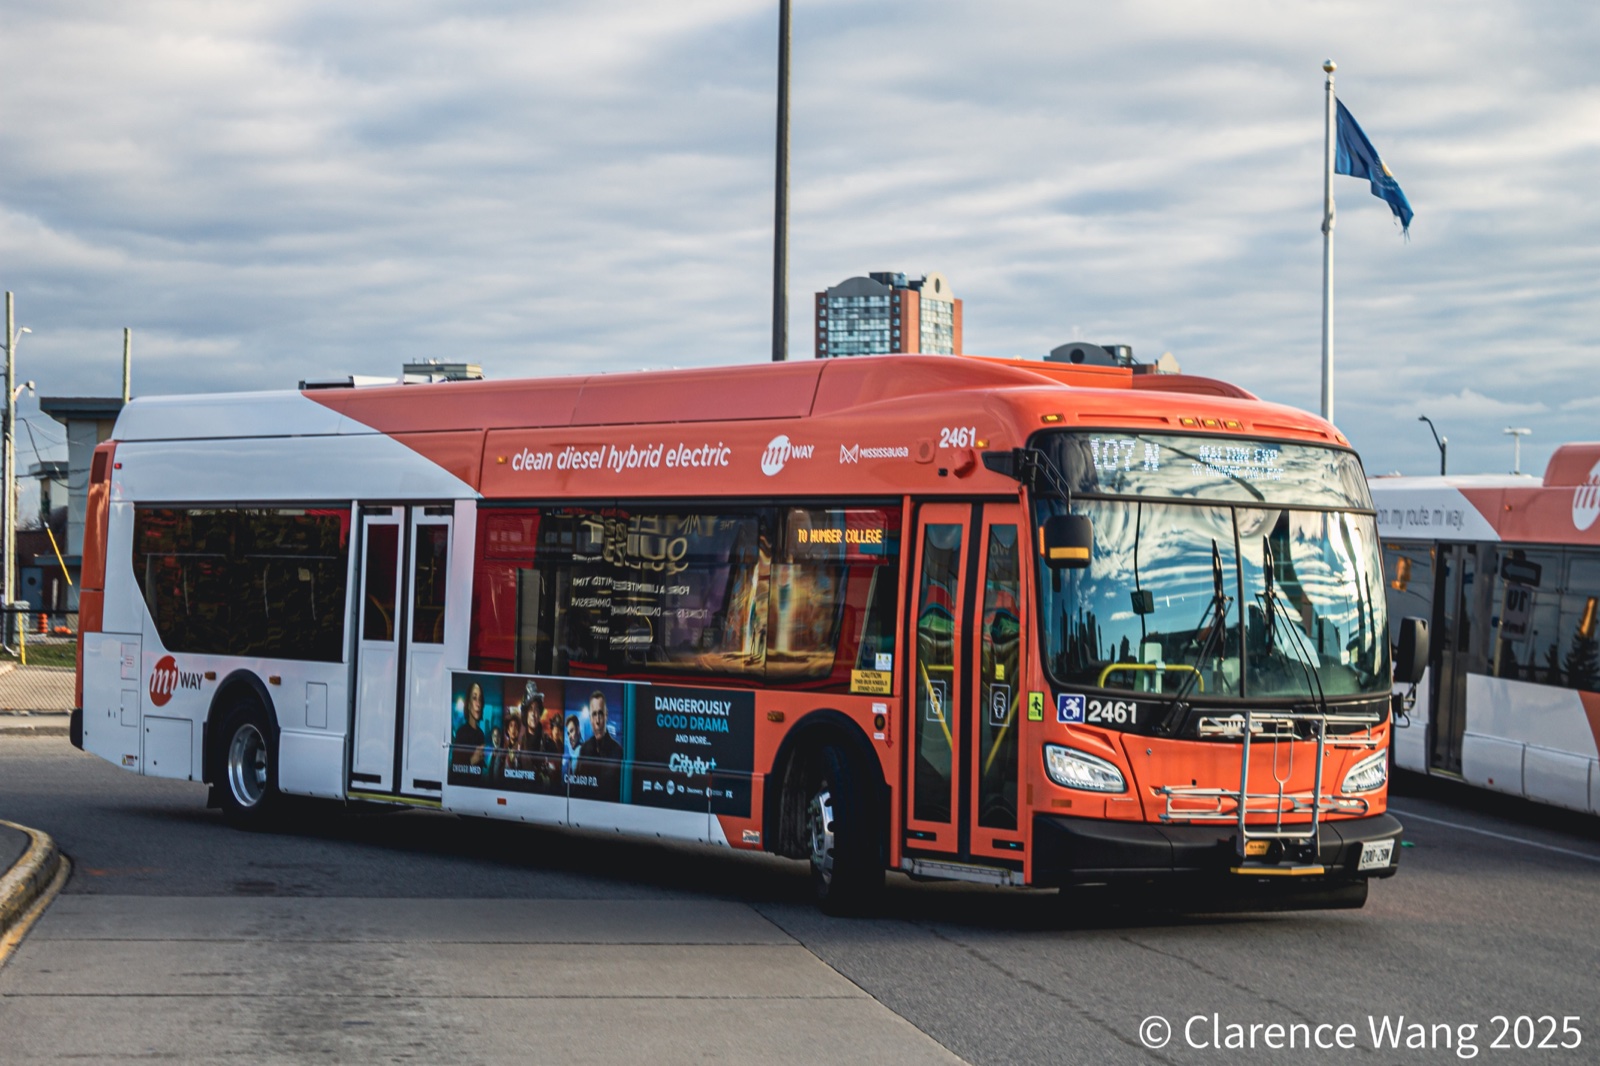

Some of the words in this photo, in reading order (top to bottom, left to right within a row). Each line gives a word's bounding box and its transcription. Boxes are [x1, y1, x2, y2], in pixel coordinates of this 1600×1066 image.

[939, 427, 976, 448] 2461
[512, 448, 553, 471] clean
[556, 445, 606, 470] diesel
[607, 443, 664, 474] hybrid
[665, 442, 731, 468] electric
[1091, 438, 1136, 471] 107
[1144, 443, 1160, 471] N
[810, 528, 843, 544] HUMBER
[845, 528, 883, 544] COLLEGE
[180, 671, 203, 690] WAY
[654, 696, 732, 716] DANGEROUSLY
[1087, 700, 1137, 724] 2461
[656, 713, 688, 729] GOOD
[689, 716, 729, 733] DRAMA
[675, 734, 689, 744] AND
[564, 773, 588, 786] CHICAGO
